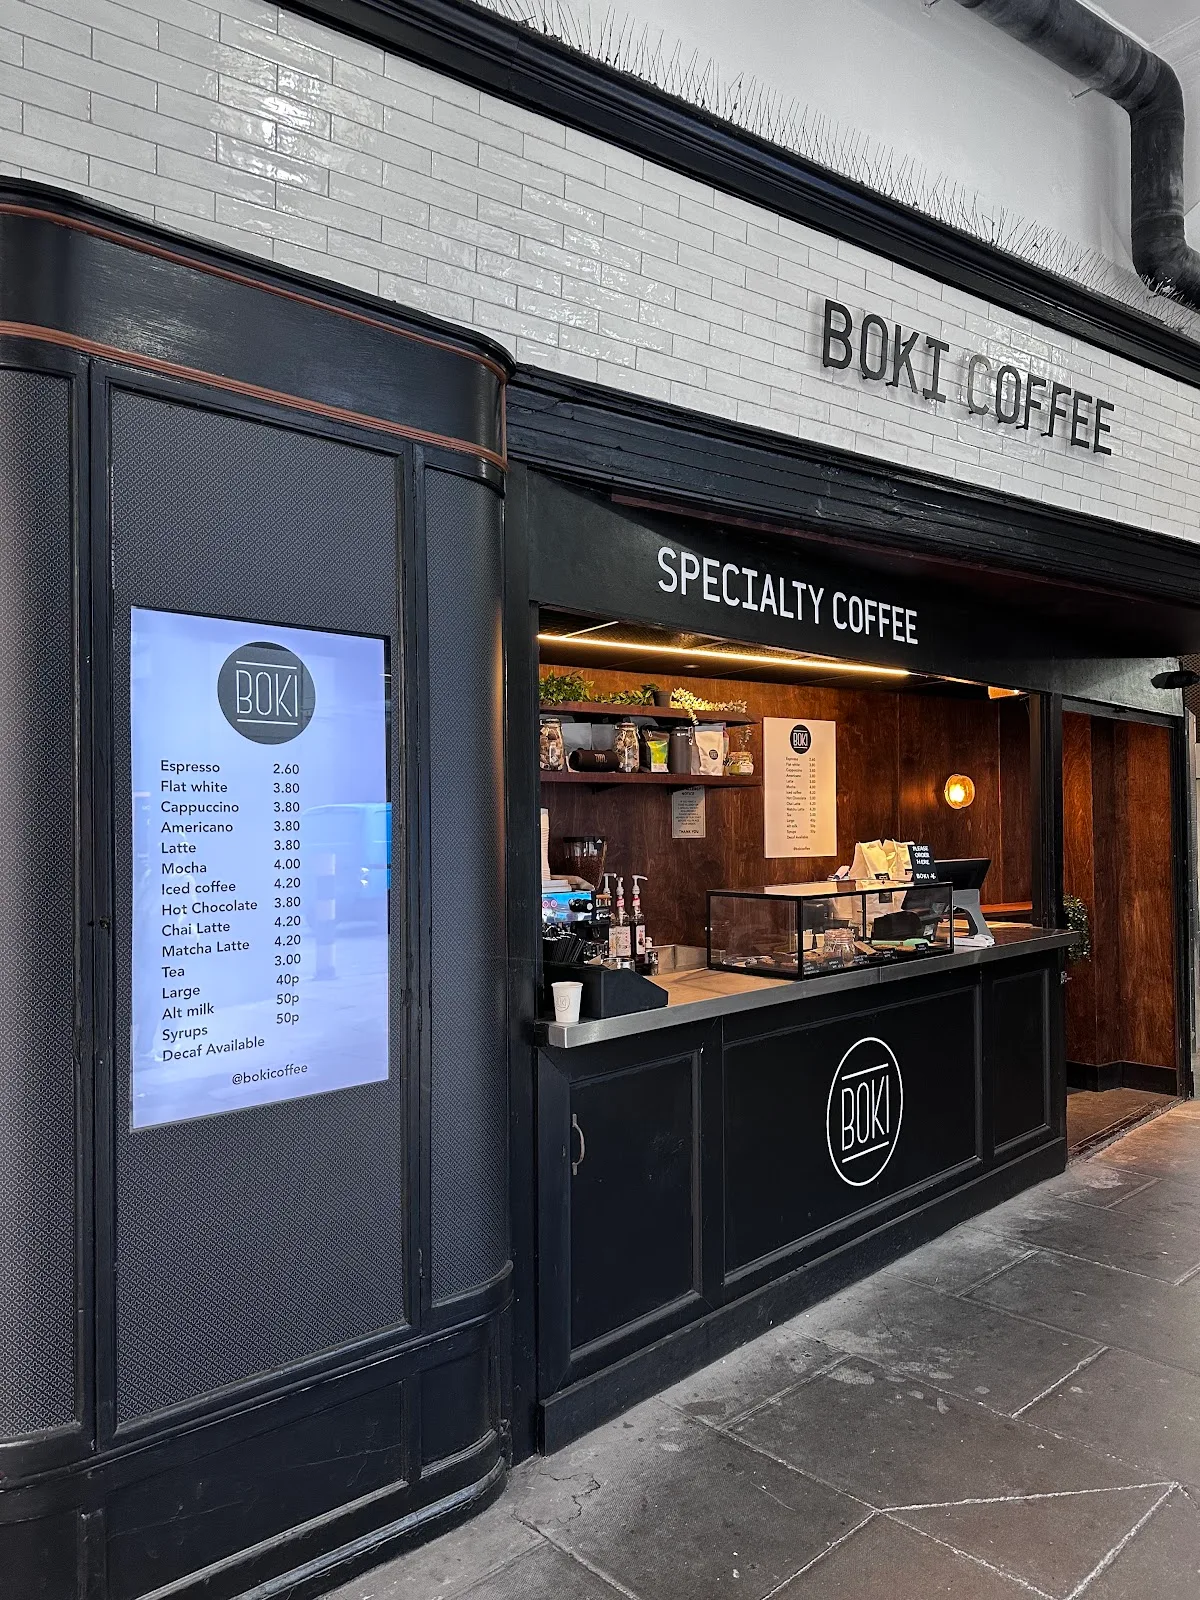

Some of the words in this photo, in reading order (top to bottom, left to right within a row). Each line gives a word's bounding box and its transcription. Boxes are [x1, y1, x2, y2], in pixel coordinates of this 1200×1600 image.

[822, 298, 950, 404] BOKI
[966, 353, 1115, 456] COFFEE
[657, 546, 825, 625] SPECIALTY
[832, 591, 919, 645] COFFEE
[235, 669, 298, 718] BOKI
[793, 732, 808, 747] BOKI
[160, 760, 221, 775] Espresso
[272, 763, 300, 775] 2.60
[160, 780, 187, 793] Flat
[190, 781, 228, 794] white
[272, 782, 300, 794] 3.80
[160, 801, 239, 815] Cappuccino
[273, 802, 300, 813] 3.80
[160, 822, 234, 833] Americano
[273, 821, 301, 832] 3.80
[161, 842, 197, 854] Latte
[273, 840, 301, 851] 3.80
[161, 862, 208, 875] Mocha
[273, 858, 301, 870] 4.00
[161, 882, 190, 896] Iced
[195, 880, 236, 894] coffee
[274, 877, 301, 889] 4.20
[161, 902, 188, 916] Hot
[191, 899, 258, 914] Chocolate
[274, 896, 301, 908] 3.80
[161, 923, 192, 937] Chai
[196, 922, 231, 934] Latte
[274, 915, 301, 927] 4.20
[162, 943, 212, 958] Matcha
[216, 940, 250, 953] Latte
[274, 934, 301, 946] 4.20
[162, 966, 185, 979] Tea
[274, 954, 301, 966] 3.00
[162, 985, 201, 1000] Large
[276, 973, 300, 987] 40p
[162, 1006, 183, 1021] Alt
[187, 1002, 215, 1018] milk
[276, 993, 300, 1006] 50p
[162, 1025, 208, 1043] Syrups
[276, 1012, 300, 1026] 50p
[162, 1044, 203, 1062] Decaf
[205, 1036, 265, 1056] Available
[231, 1063, 308, 1086] @bokicoffee
[841, 1074, 890, 1151] BOKI
